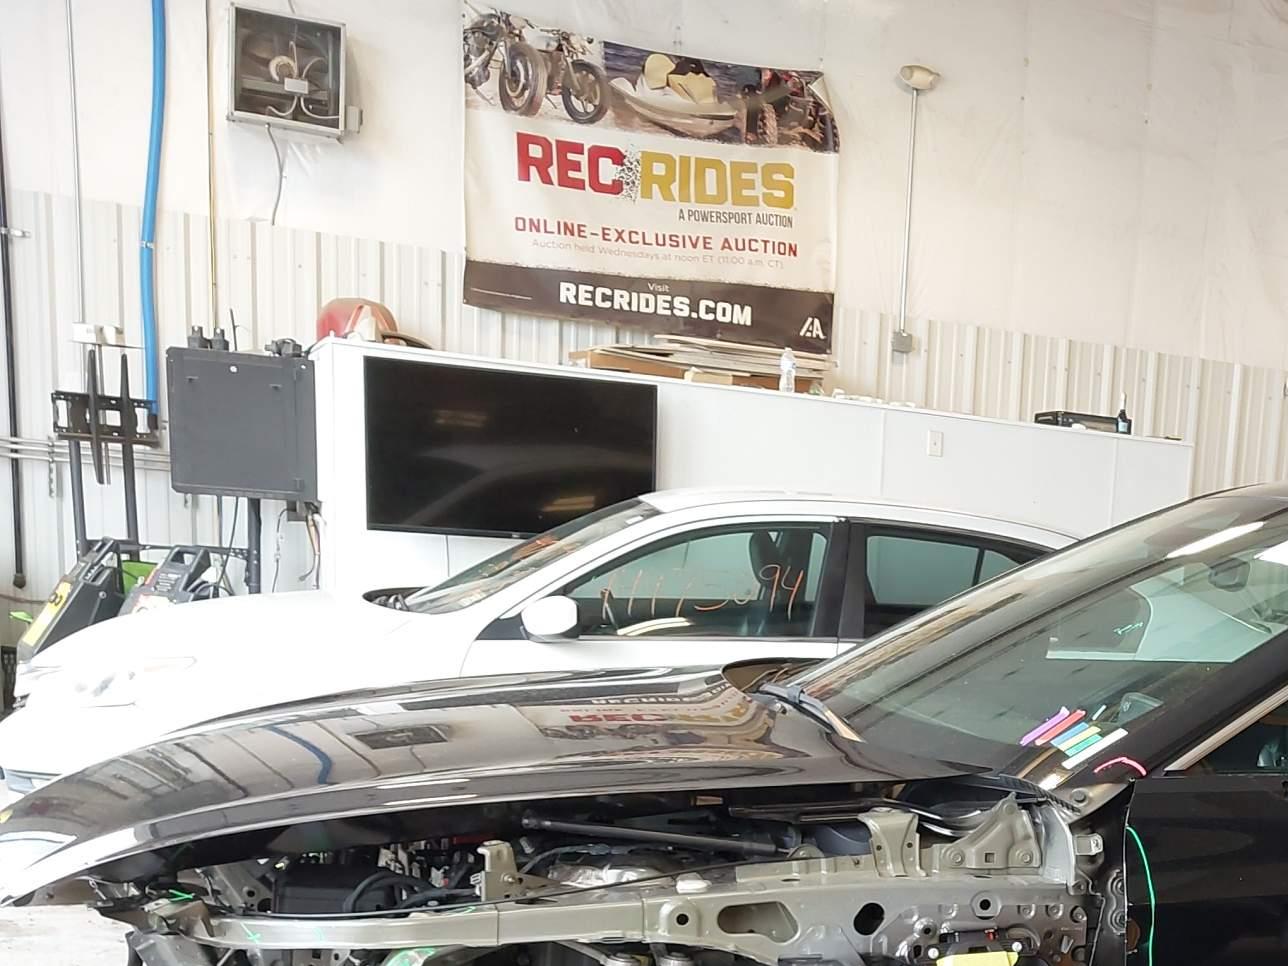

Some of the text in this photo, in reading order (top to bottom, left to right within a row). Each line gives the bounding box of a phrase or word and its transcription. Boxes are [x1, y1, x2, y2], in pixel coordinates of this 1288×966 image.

[516, 132, 795, 209] REC RIDES
[678, 208, 793, 229] A POWERSPORT AUCTION
[514, 216, 798, 257] ONLINE-EXCLUSIVE AUCTION
[532, 239, 572, 250] Auction
[647, 282, 670, 293] Visit
[559, 281, 753, 327] RECRIDES.COM
